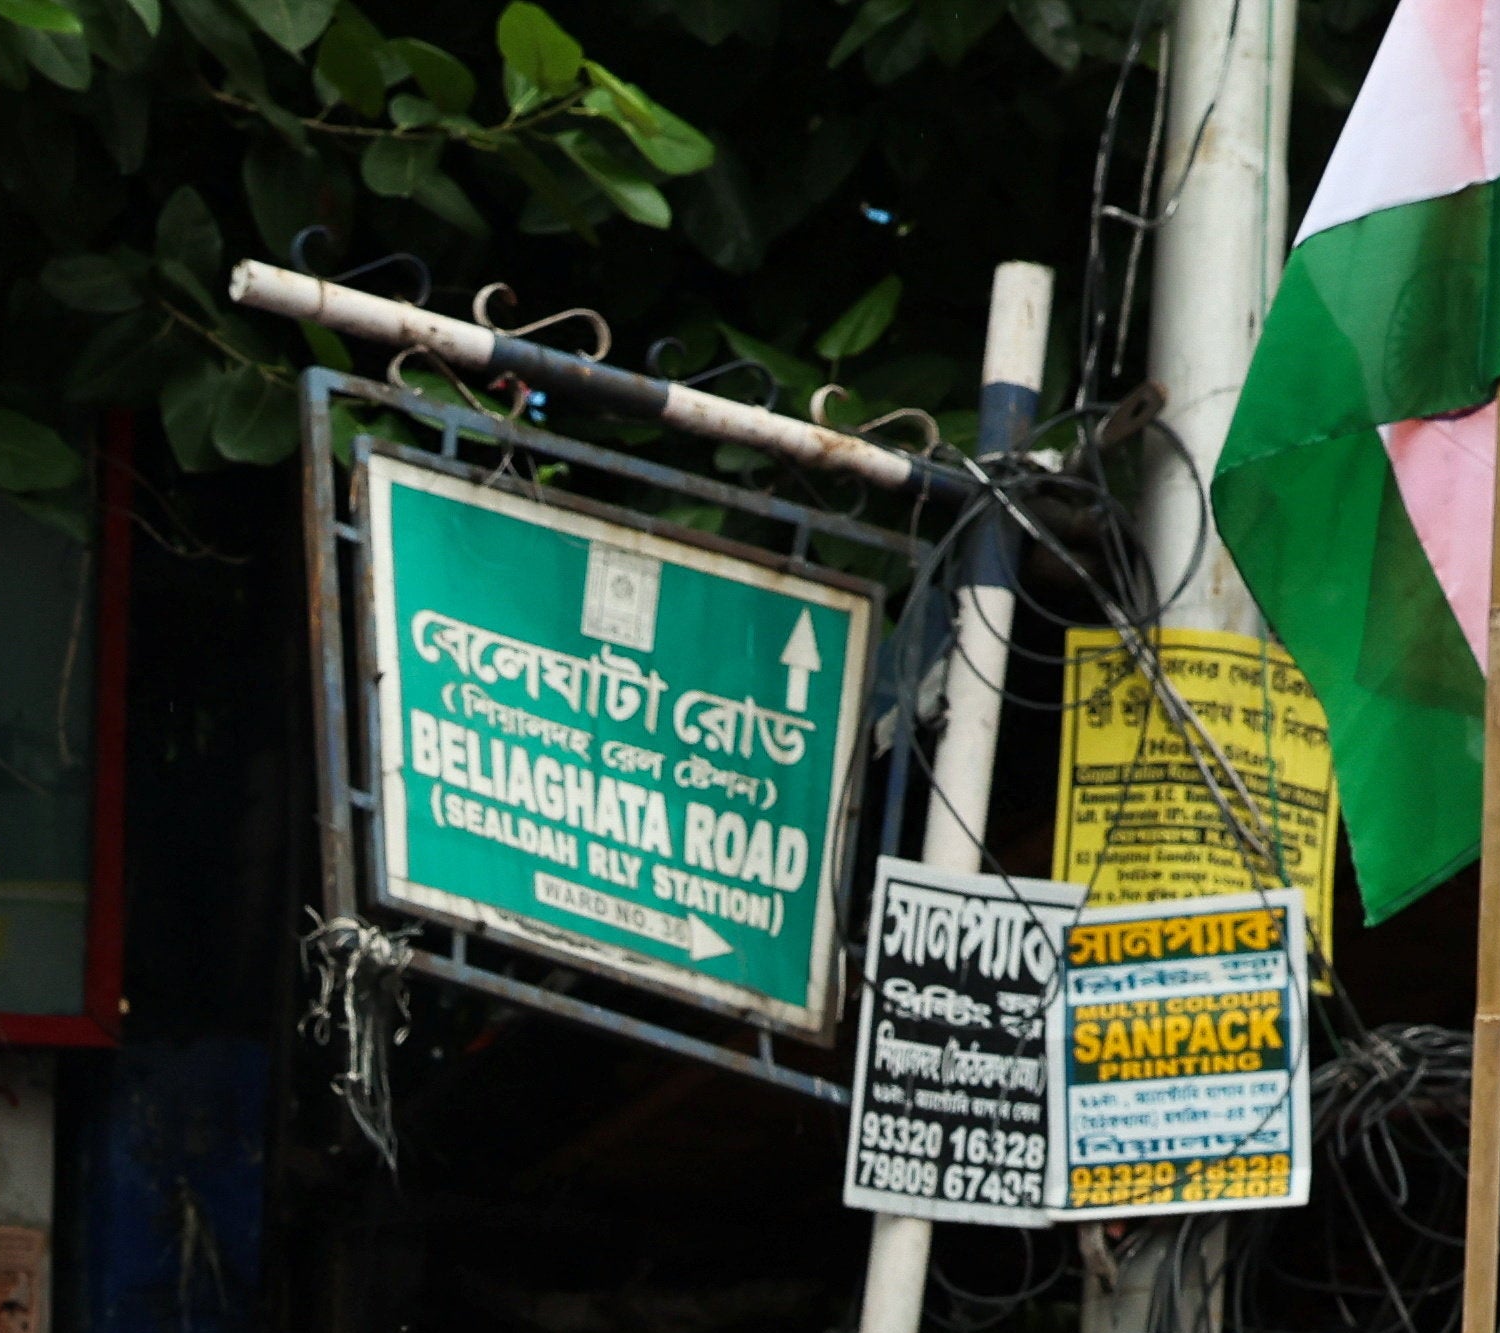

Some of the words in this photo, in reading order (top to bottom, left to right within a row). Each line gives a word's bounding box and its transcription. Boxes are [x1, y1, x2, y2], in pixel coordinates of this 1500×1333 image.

[412, 609, 669, 734] বেলেঘাটা
[672, 690, 816, 766] রোড
[602, 740, 666, 779] রেল
[410, 708, 672, 858] BELIAGHATA
[683, 802, 808, 893] ROAD
[430, 784, 578, 869] (SEALDAH
[587, 840, 643, 890] RLY
[650, 863, 784, 938] STATION)
[541, 873, 611, 918] WARD
[1068, 906, 1285, 966] সানপ্যাক
[1075, 999, 1160, 1022] MULTI
[1165, 989, 1282, 1015] COLOUR
[1073, 1007, 1284, 1064] SANPACK
[1097, 1051, 1263, 1082] PRINTING
[862, 1111, 944, 1159] 93320
[950, 1125, 1046, 1170] 16328
[859, 1150, 939, 1197] 79809
[1070, 1160, 1177, 1190] 93320
[1184, 1152, 1291, 1183] 16328
[1181, 1178, 1290, 1202] 67405
